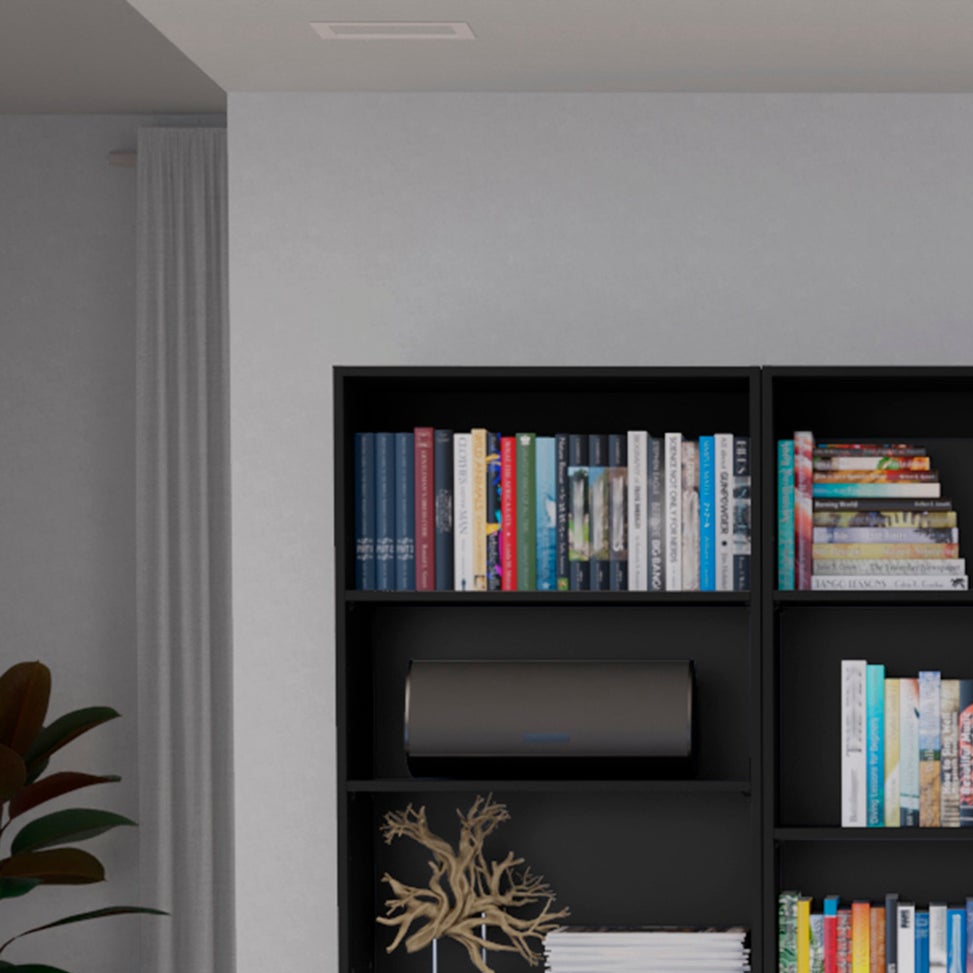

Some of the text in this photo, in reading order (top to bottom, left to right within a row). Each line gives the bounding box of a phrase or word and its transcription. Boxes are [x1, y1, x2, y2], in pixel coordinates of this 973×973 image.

[668, 436, 679, 468] SCIENCE
[668, 469, 679, 489] NOT
[668, 490, 679, 517] ONLY
[719, 471, 730, 535] GUNPOWDER
[868, 752, 881, 765] for
[942, 759, 953, 770] to
[960, 712, 972, 795] Beautiful Music
[868, 766, 881, 798] Lessons
[942, 773, 953, 795] How
[868, 800, 881, 825] Diving
